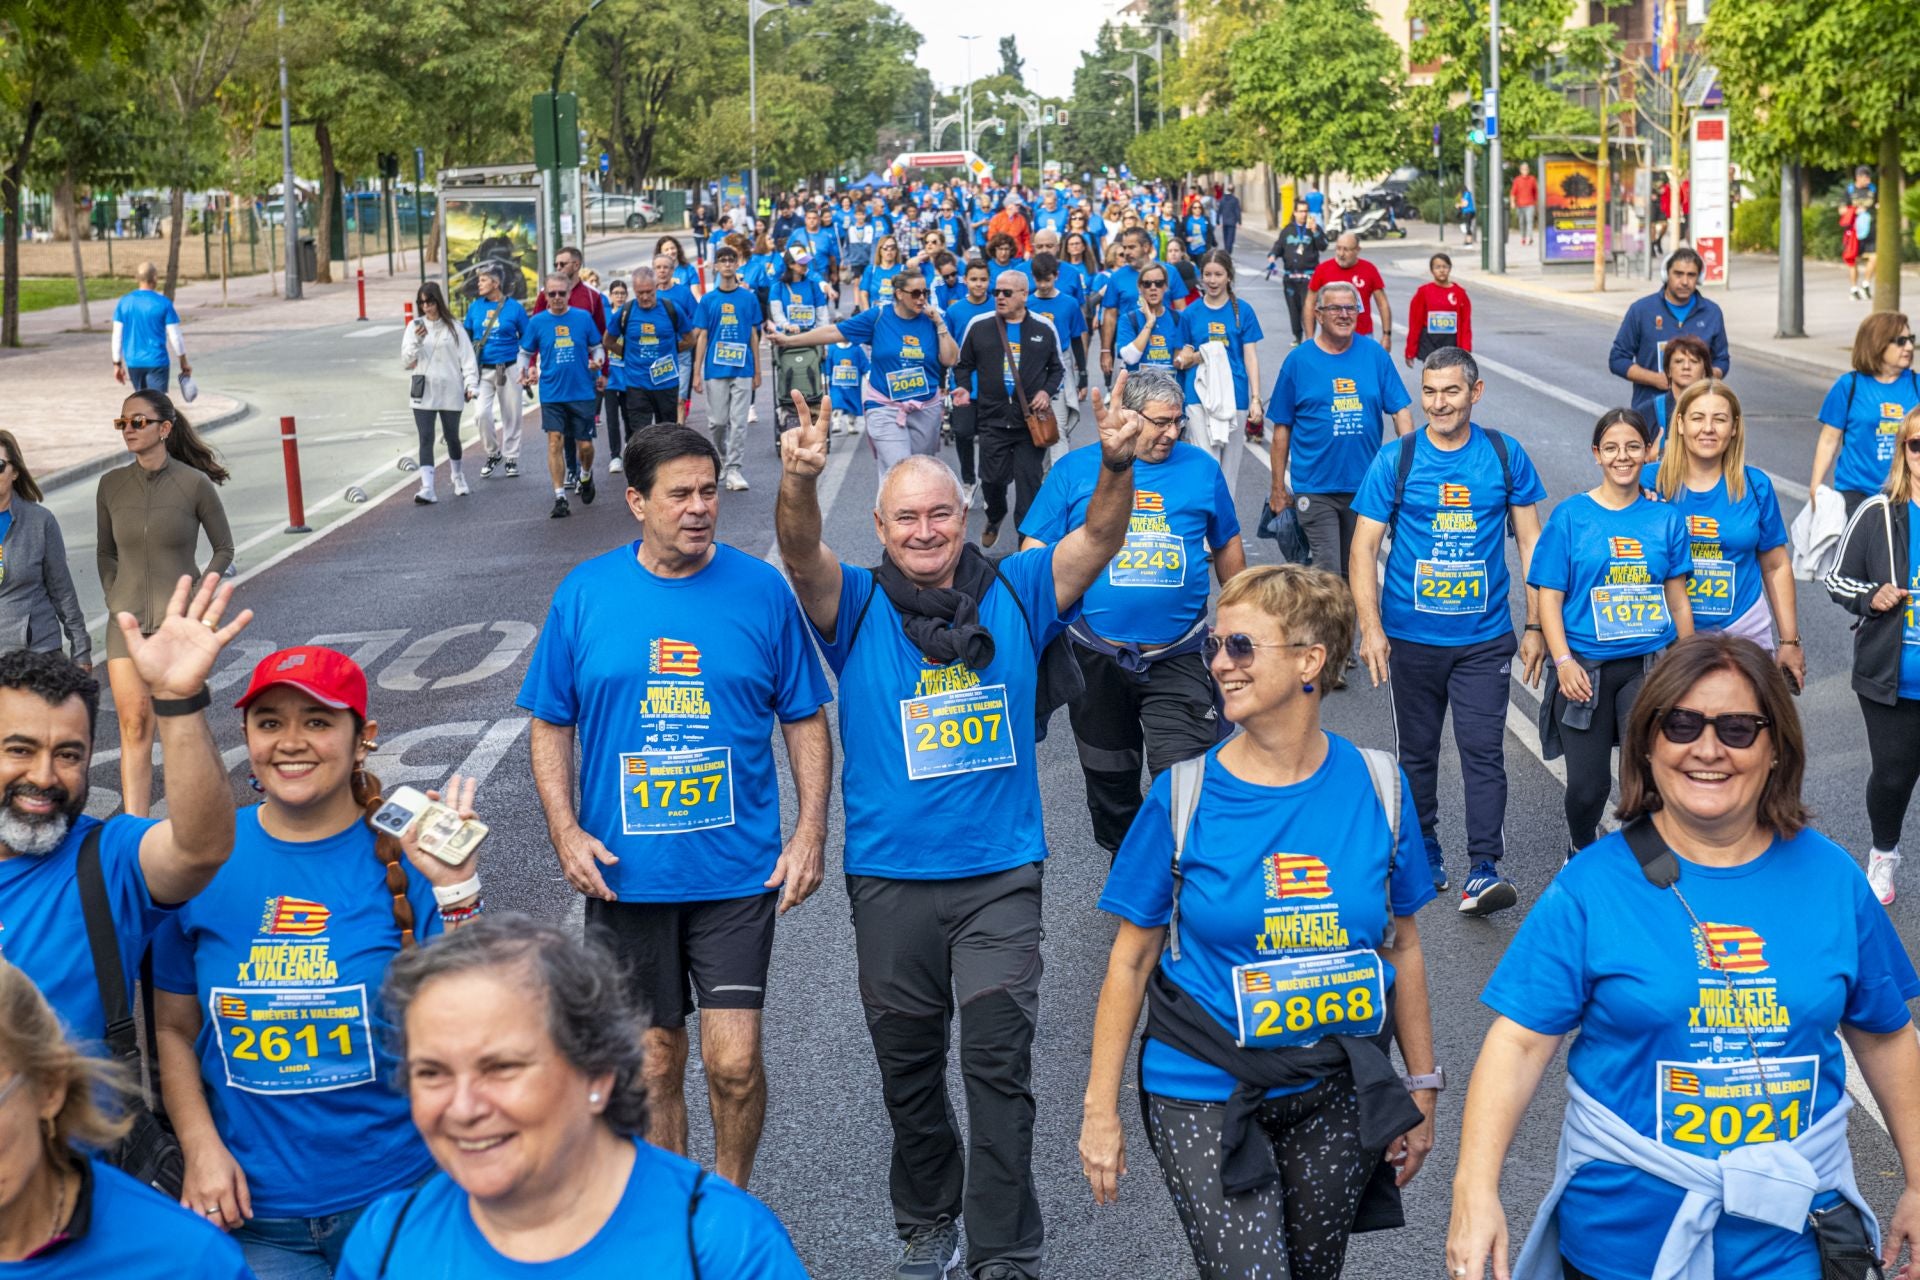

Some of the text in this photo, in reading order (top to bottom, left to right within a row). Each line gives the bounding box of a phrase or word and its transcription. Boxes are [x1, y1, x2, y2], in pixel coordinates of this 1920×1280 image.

[717, 349, 743, 360] 2341
[653, 365, 674, 378] 2345
[893, 377, 925, 392] 2048
[1117, 550, 1180, 570] 2243
[1605, 573, 1651, 584] X VALENCIA
[1610, 565, 1648, 576] MUÉVETE
[1421, 579, 1480, 598] 2241
[1687, 578, 1729, 598] 242
[1601, 604, 1664, 623] 1972
[647, 683, 705, 701] MUÉVETE
[915, 671, 981, 695] X VALENCIA
[640, 700, 711, 715] X VALENCIA
[915, 714, 1001, 752] 2807
[692, 761, 726, 774] VALENCIA
[633, 775, 723, 809] 1757
[1265, 909, 1339, 934] MUÉVETE
[1256, 928, 1349, 950] X VALENCIA
[250, 941, 329, 963] MUÉVETE
[237, 961, 339, 981] X VALENCIA
[1276, 967, 1375, 992] MUÉVETE X VALENCIA
[252, 1006, 360, 1020] MUÉVETE X VALENCIA
[1252, 987, 1374, 1038] 2868
[1688, 1006, 1790, 1027] X VALENCIA
[230, 1024, 352, 1062] 2611
[279, 1064, 310, 1073] LINDA
[1704, 1083, 1752, 1098] MUÉVETE
[1755, 1085, 1762, 1096] X
[1673, 1099, 1800, 1144] 2021
